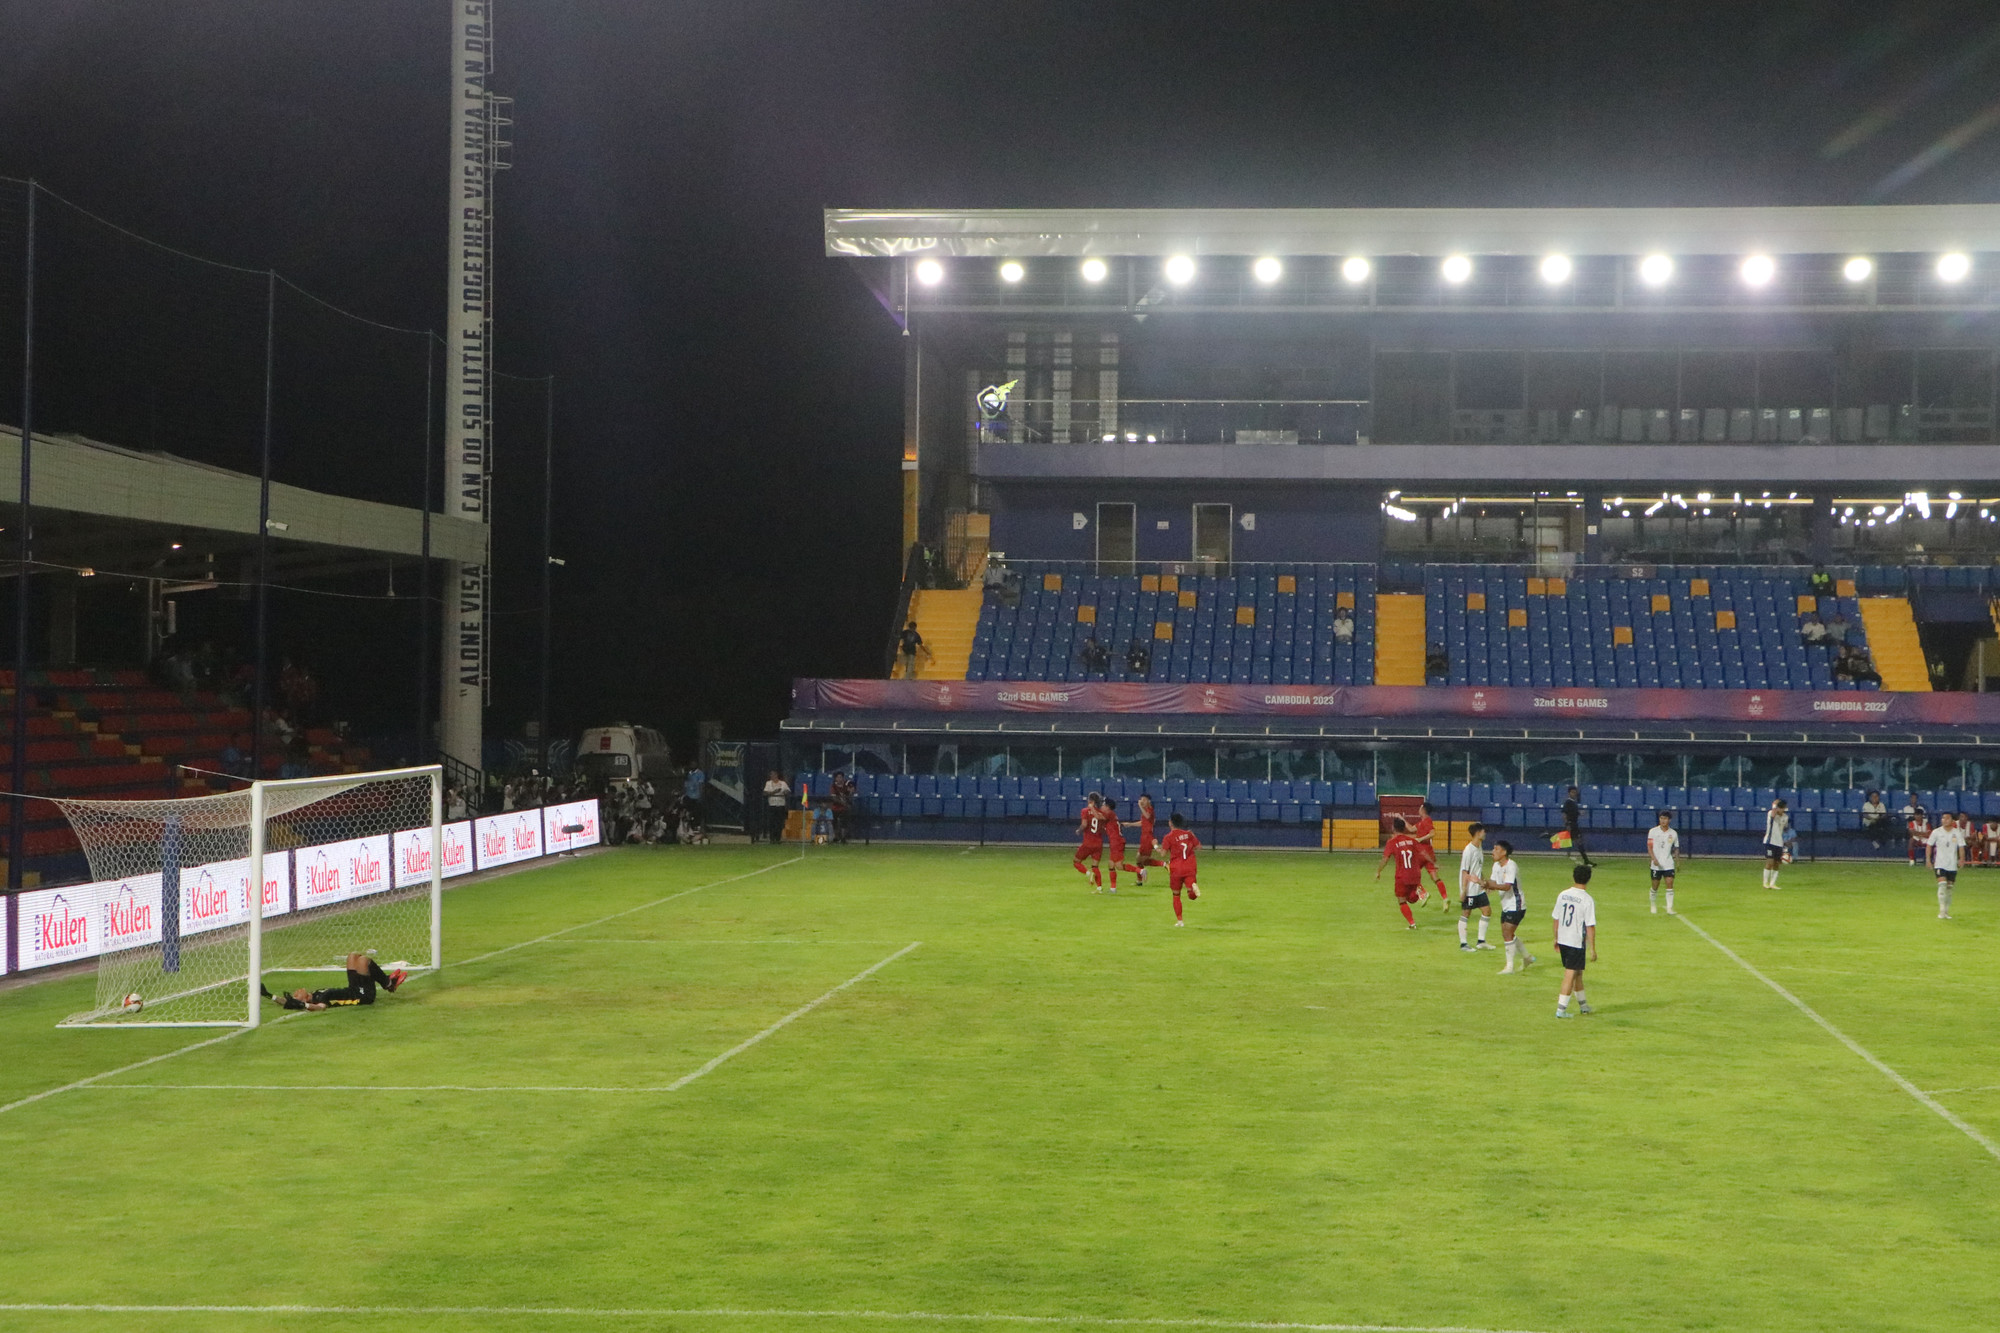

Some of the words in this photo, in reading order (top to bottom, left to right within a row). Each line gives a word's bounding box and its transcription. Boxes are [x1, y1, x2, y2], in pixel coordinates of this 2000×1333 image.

[464, 24, 484, 53] DO
[464, 60, 485, 101] CAN
[463, 108, 484, 199] VISAKHA
[463, 207, 483, 313] TOGETHER
[462, 322, 482, 396] LITTLE.
[462, 404, 482, 430] SO
[462, 437, 482, 465] DO
[461, 473, 482, 512] CAN
[1174, 564, 1185, 574] S1
[1632, 567, 1644, 577] S2
[460, 565, 482, 614] VISA
[997, 691, 1019, 701] 32nd
[1020, 692, 1037, 702] SEA
[1038, 692, 1069, 702] GAMES
[1264, 695, 1311, 705] CAMBODIA
[1313, 695, 1334, 705] 2023
[1533, 698, 1556, 707] 32nd
[1557, 698, 1575, 707] SEA
[1576, 698, 1608, 708] GAMES
[1813, 701, 1862, 711] CAMBODIA
[1864, 702, 1887, 711] 2023
[514, 824, 536, 851] Kulen
[1090, 817, 1098, 834] 9
[442, 838, 465, 867] Kulen
[486, 829, 507, 857] Kulen
[1180, 842, 1188, 860] 7
[354, 853, 381, 886] Kulen
[406, 843, 432, 874] Kulen
[1401, 849, 1413, 869] 17
[310, 861, 341, 895] Kulen
[192, 881, 229, 920] Kulen
[1562, 902, 1575, 927] 13
[42, 907, 88, 951] Kulen
[110, 896, 152, 938] Kulen
